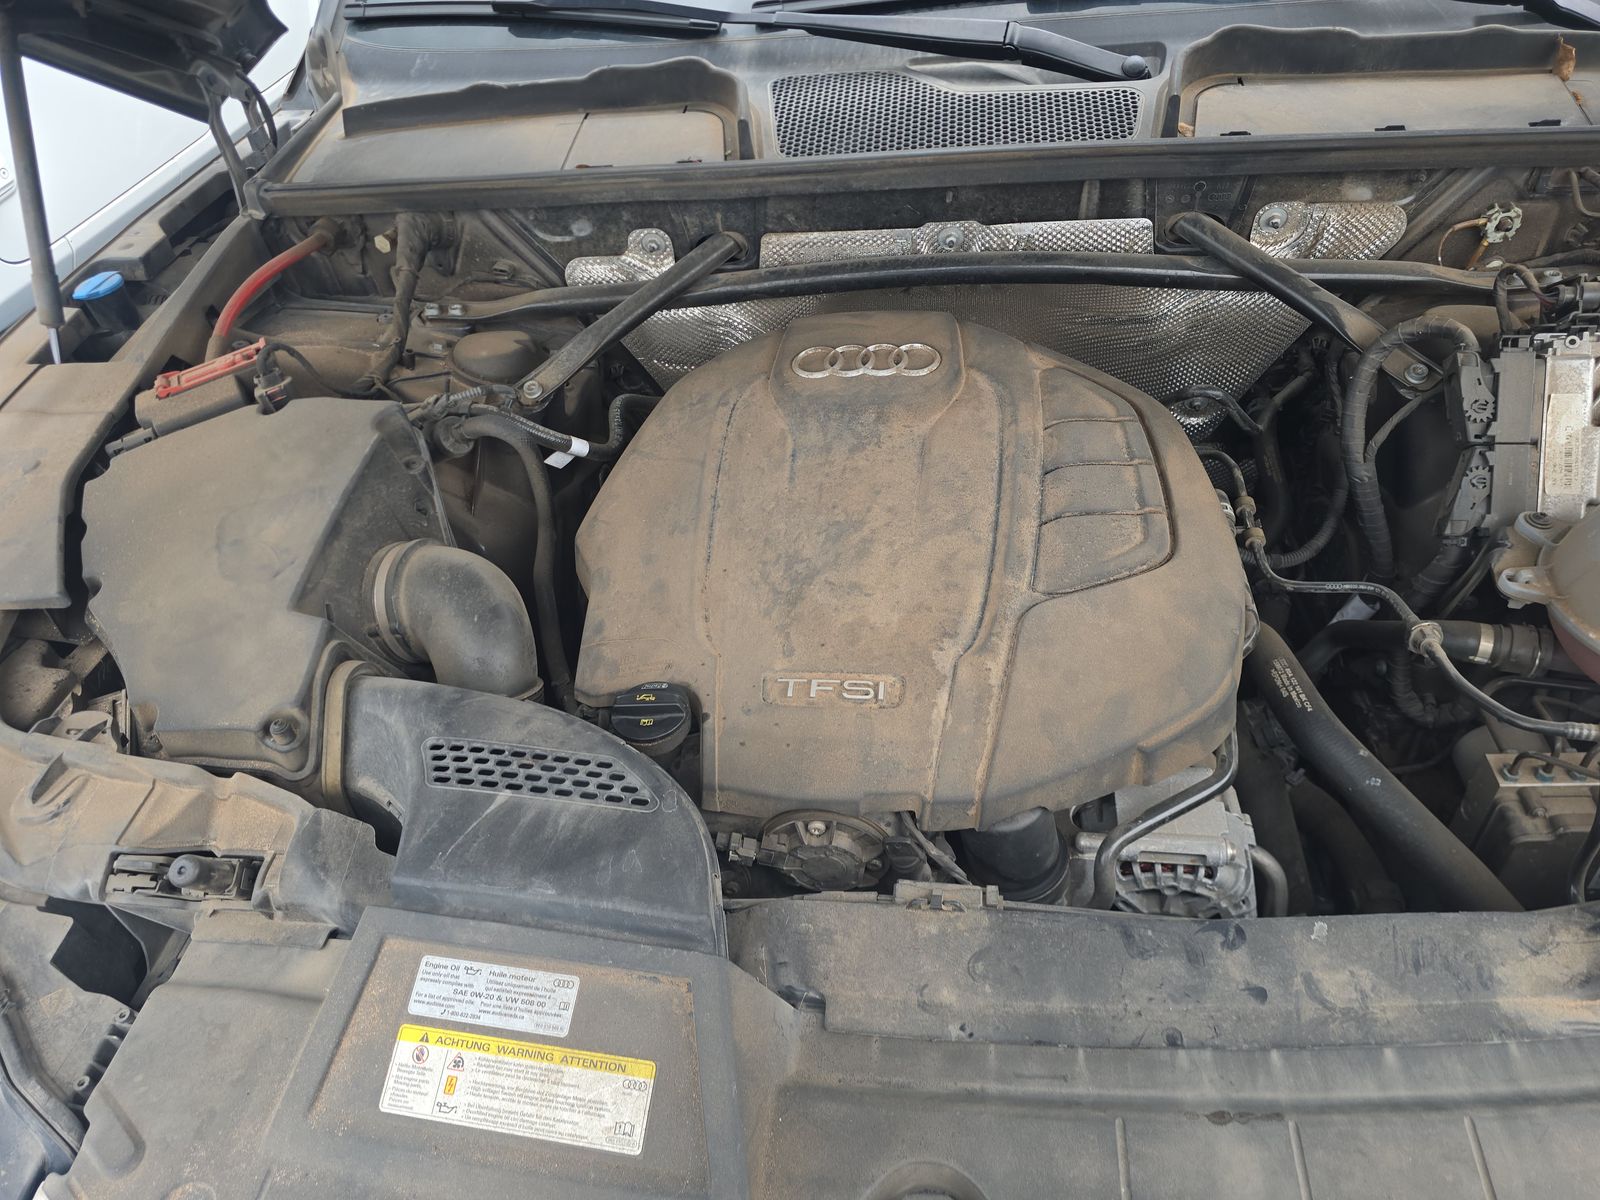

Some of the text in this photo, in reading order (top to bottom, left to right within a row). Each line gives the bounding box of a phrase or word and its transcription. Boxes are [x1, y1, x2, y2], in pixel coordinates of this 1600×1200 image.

[777, 678, 885, 700] TFSI
[424, 961, 448, 970] Engine
[508, 974, 536, 982] moteur
[470, 991, 494, 1000] 0W-20
[506, 996, 520, 1004] VW
[435, 1036, 491, 1052] ACHTUNG
[496, 1045, 554, 1062] WARNING
[560, 1055, 627, 1073] ATTENTION
